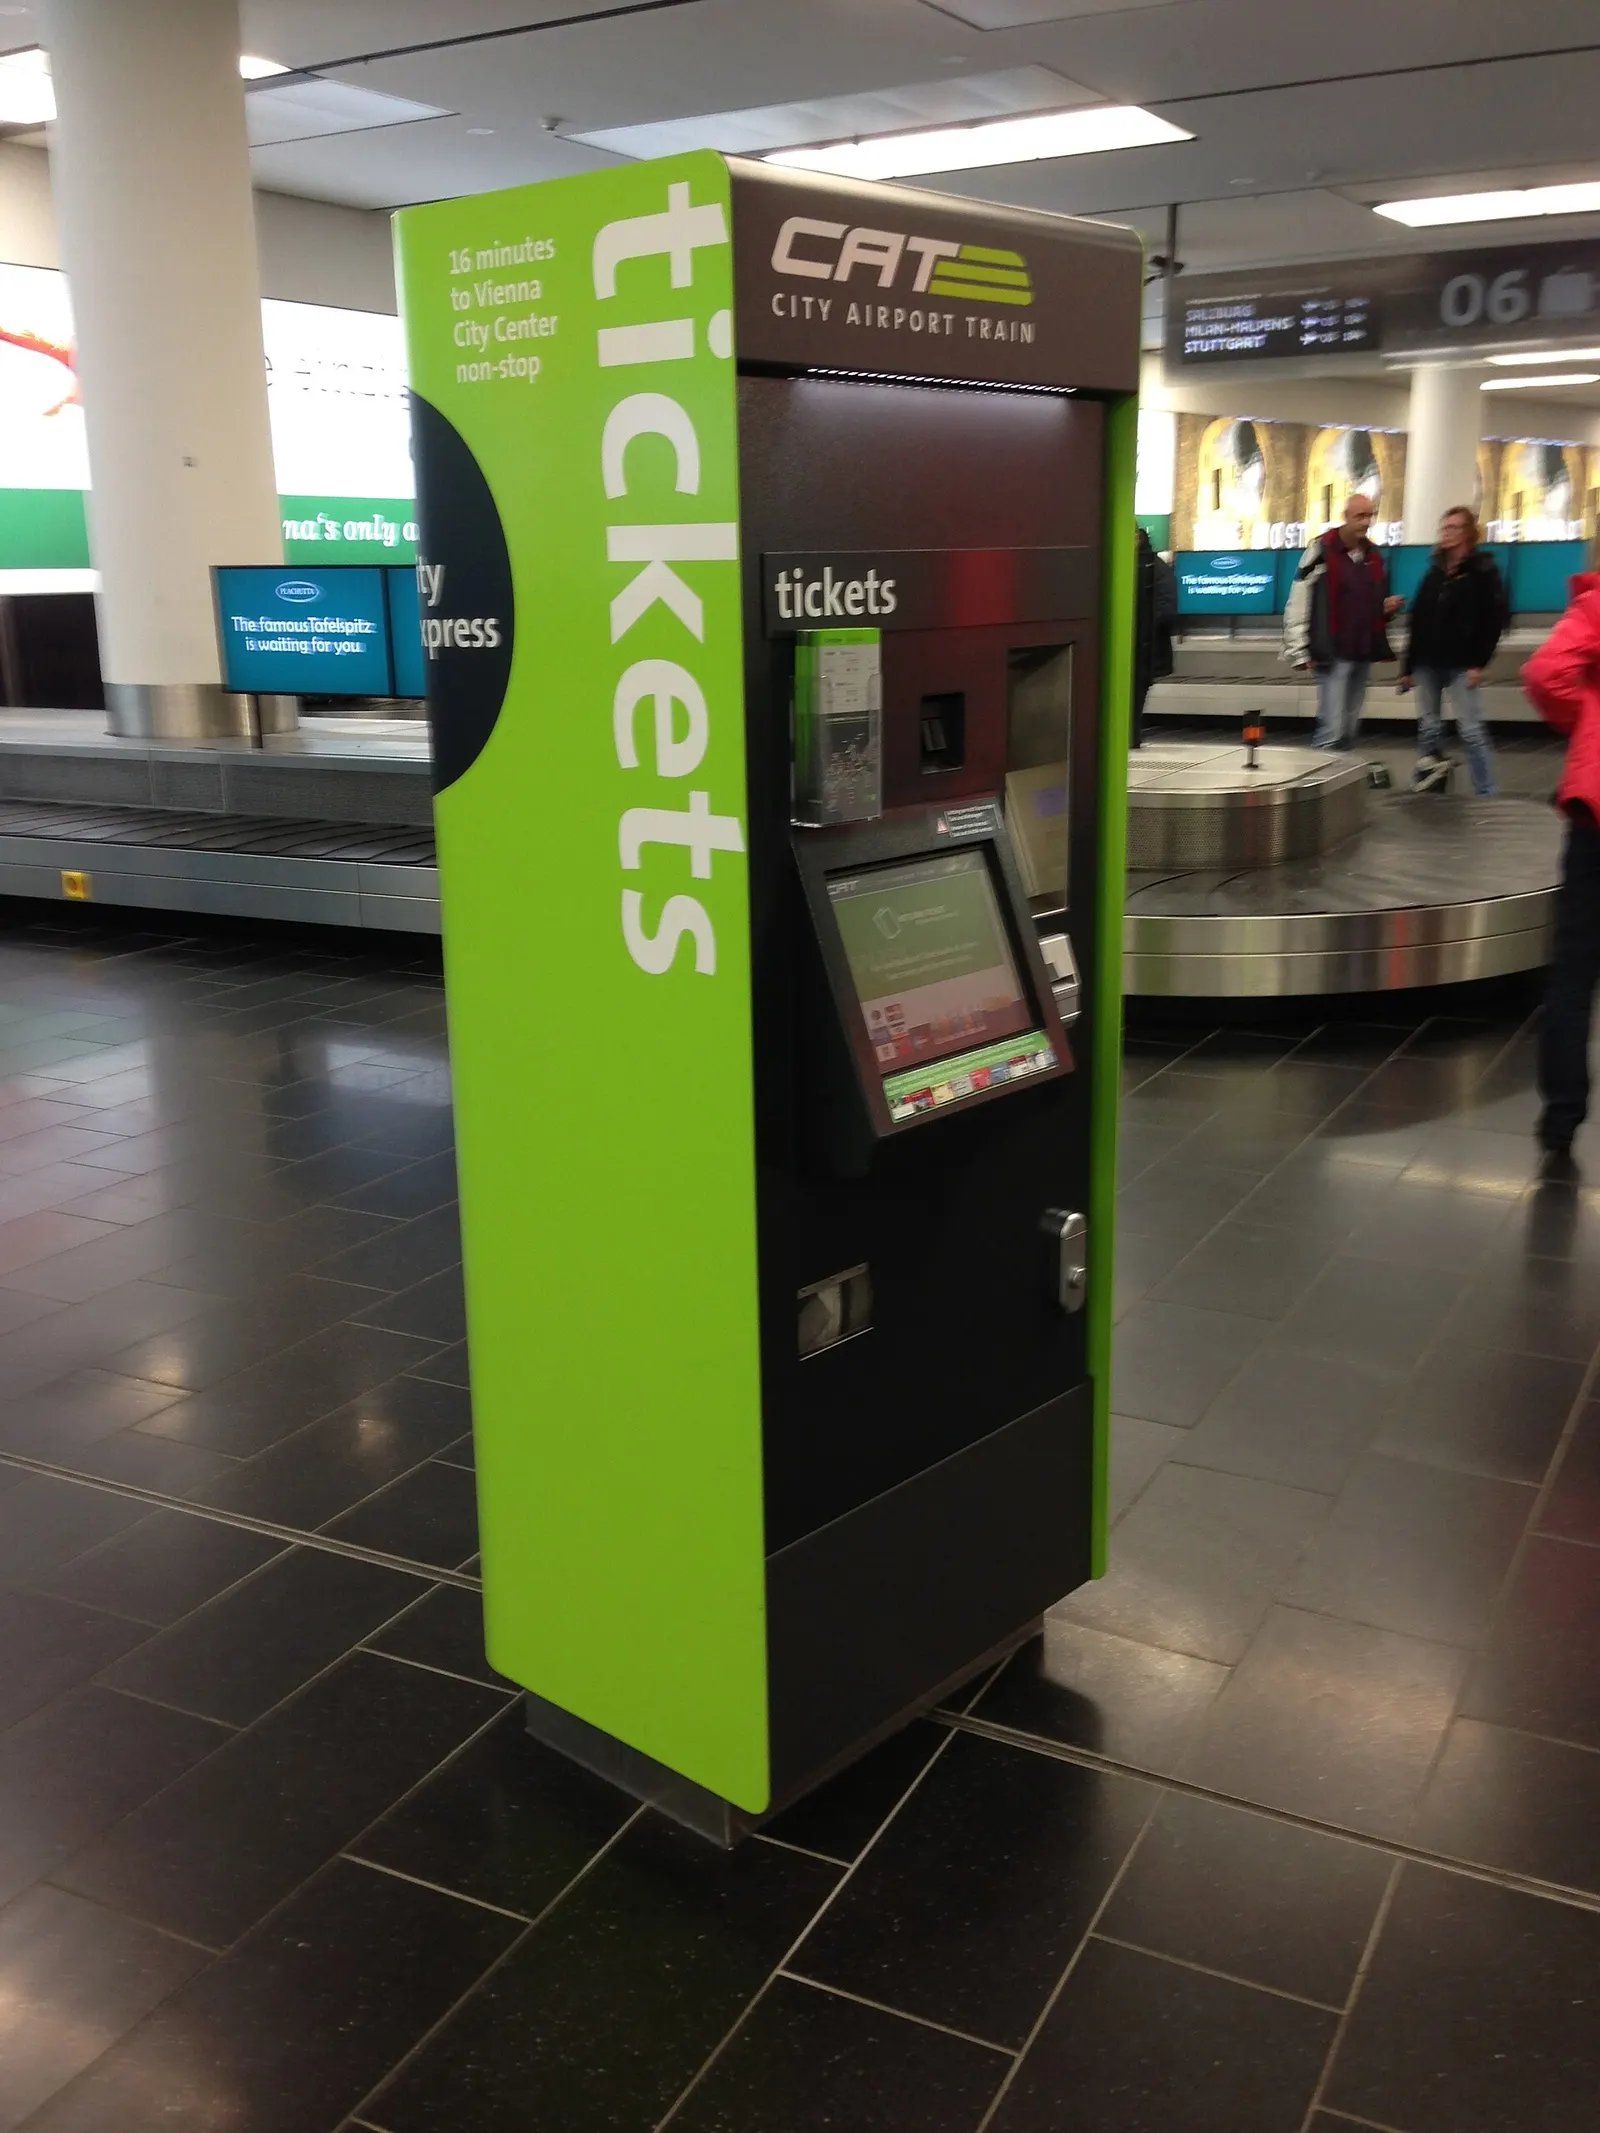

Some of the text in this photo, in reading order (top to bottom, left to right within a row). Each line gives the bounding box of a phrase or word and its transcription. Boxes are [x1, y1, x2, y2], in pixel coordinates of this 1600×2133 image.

[449, 236, 556, 275] 16 minutes
[771, 216, 960, 293] CAT
[451, 279, 542, 311] to Vienna
[1440, 269, 1529, 326] 06
[454, 313, 558, 353] City Center
[771, 293, 1038, 344] CITY AIRPORT TRAIN
[1184, 333, 1266, 354] STUTTGART
[456, 353, 541, 384] non-stop
[343, 514, 400, 547] only
[592, 182, 745, 975] tickets
[774, 566, 899, 619] tickets
[231, 617, 376, 636] The famous Tafelspitz
[245, 636, 365, 656] is waiting for you
